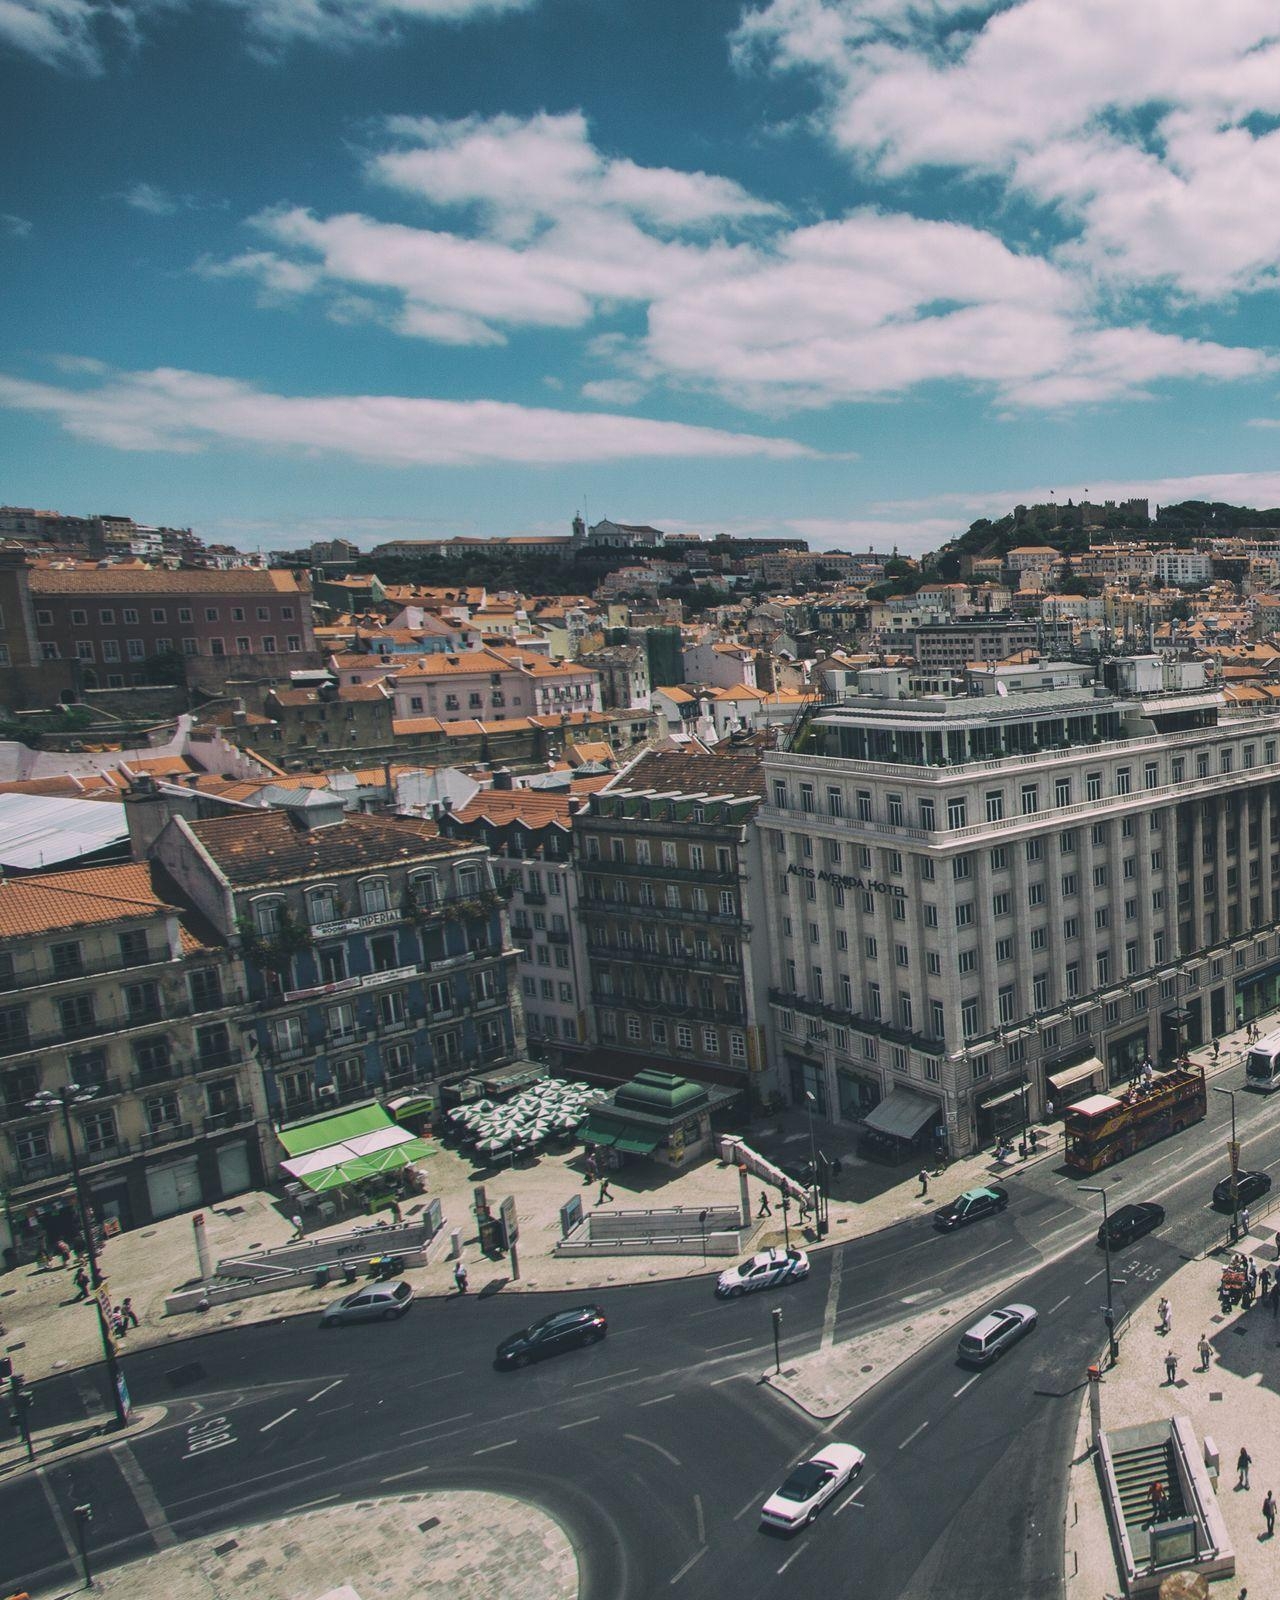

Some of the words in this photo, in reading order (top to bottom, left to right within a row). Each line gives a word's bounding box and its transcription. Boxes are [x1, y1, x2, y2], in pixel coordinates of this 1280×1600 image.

[787, 863, 815, 878] ALTIS
[818, 870, 865, 889] AVENIDA
[868, 880, 909, 898] HOTEL
[359, 910, 400, 928] IMPERIAL
[1122, 1260, 1161, 1280] BUS
[187, 1416, 233, 1452] BUS
